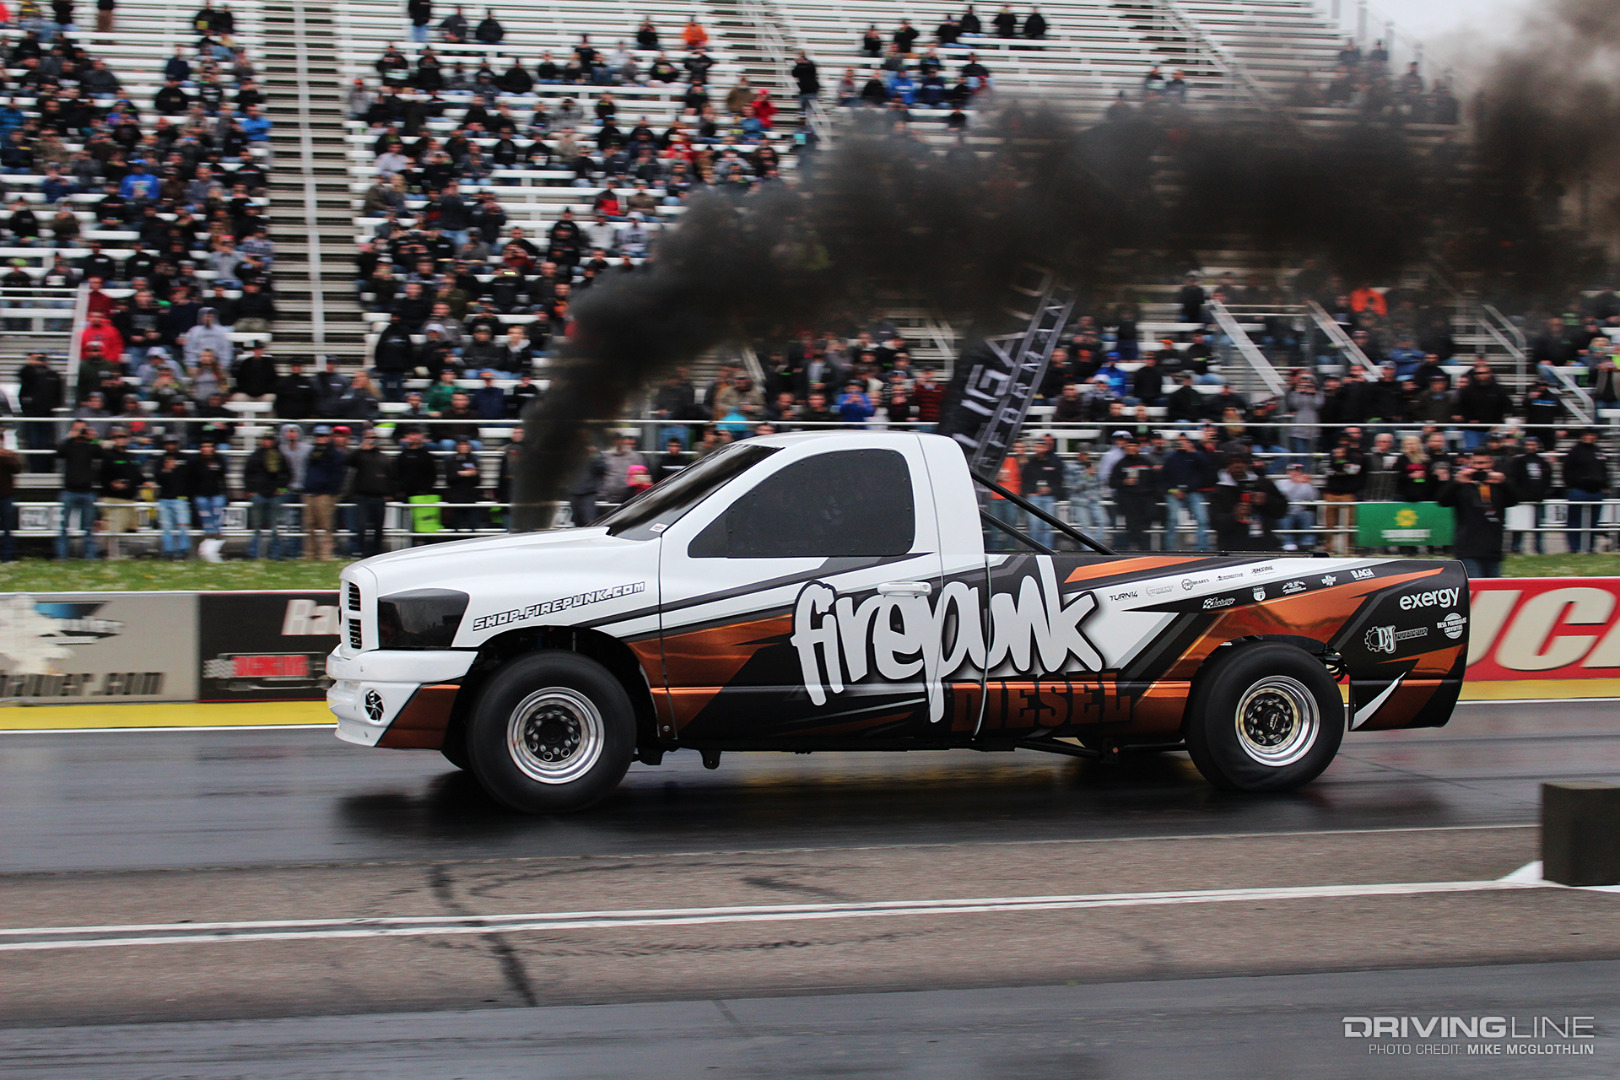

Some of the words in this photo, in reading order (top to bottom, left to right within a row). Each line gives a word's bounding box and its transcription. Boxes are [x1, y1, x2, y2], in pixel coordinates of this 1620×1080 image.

[473, 581, 646, 632] SHOP.FIREPUNK.COM
[1109, 590, 1138, 602] TURN14
[1399, 586, 1460, 611] exergy
[790, 554, 1103, 724] firepunk
[951, 672, 1131, 732] DIESEL
